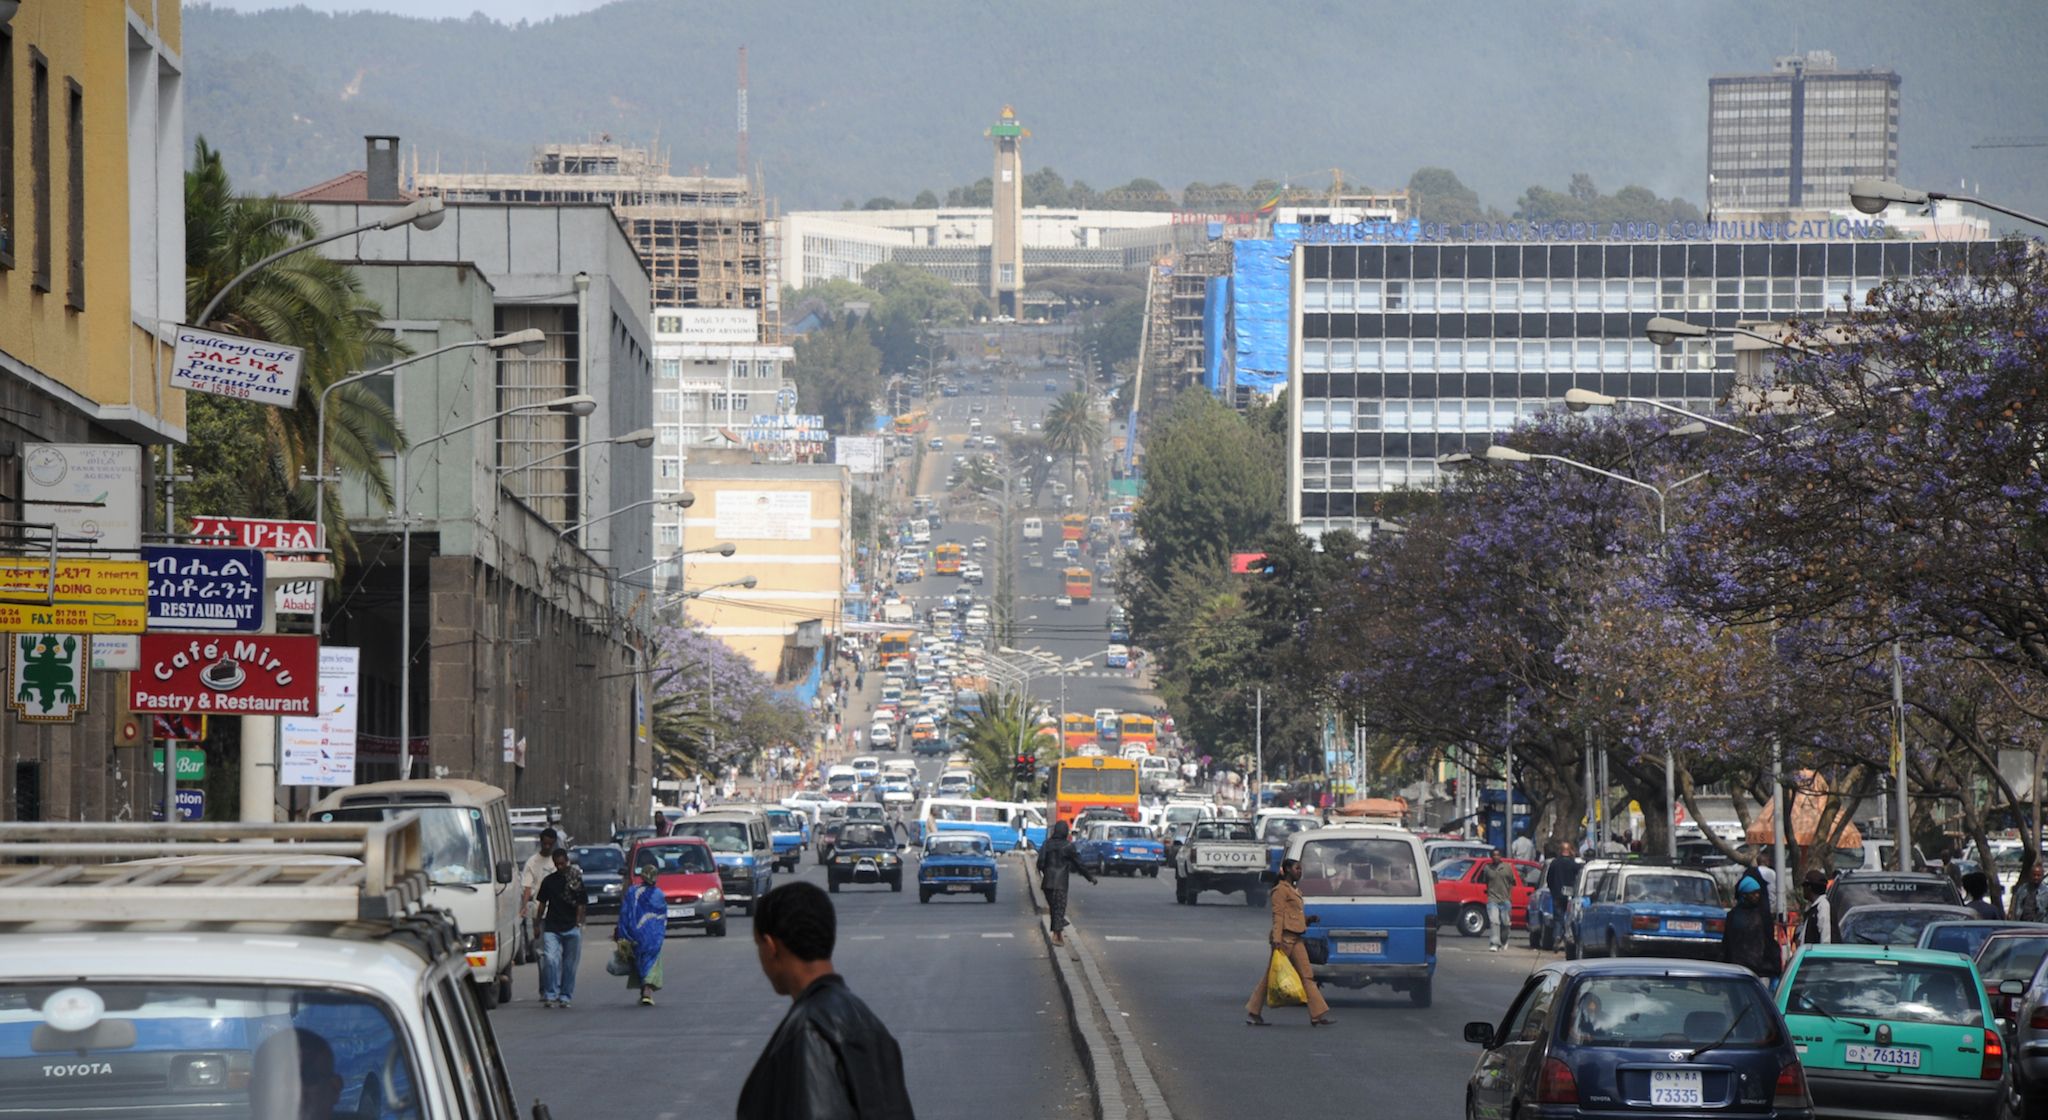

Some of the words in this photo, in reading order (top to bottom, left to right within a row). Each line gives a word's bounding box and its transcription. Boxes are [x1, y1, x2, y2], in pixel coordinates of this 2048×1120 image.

[1422, 223, 1450, 240] OF
[1460, 221, 1598, 242] TRANSPORT
[1610, 221, 1659, 241] AND
[1667, 218, 1886, 241] COMMUNICATIONS
[180, 335, 250, 355] Gallery
[252, 347, 296, 362] Café
[190, 360, 260, 382] Pastry
[266, 373, 277, 384] &
[176, 368, 292, 396] Restaurant
[211, 383, 222, 394] 15
[799, 430, 830, 441] BANK
[129, 588, 145, 596] LTD
[160, 602, 254, 619] RESTAURANT
[32, 613, 53, 625] FAX
[154, 638, 220, 681] Café
[233, 640, 293, 686] Miru
[136, 692, 194, 712] Pastry
[198, 692, 212, 709] &
[215, 693, 310, 712] Restaurant
[176, 757, 205, 773] Bar
[1205, 852, 1257, 862] TOYOTA
[1871, 883, 1917, 891] SUZUKI
[1873, 1048, 1911, 1065] 76131
[43, 1063, 113, 1077] TOYOTA
[1655, 1088, 1698, 1103] 73335
